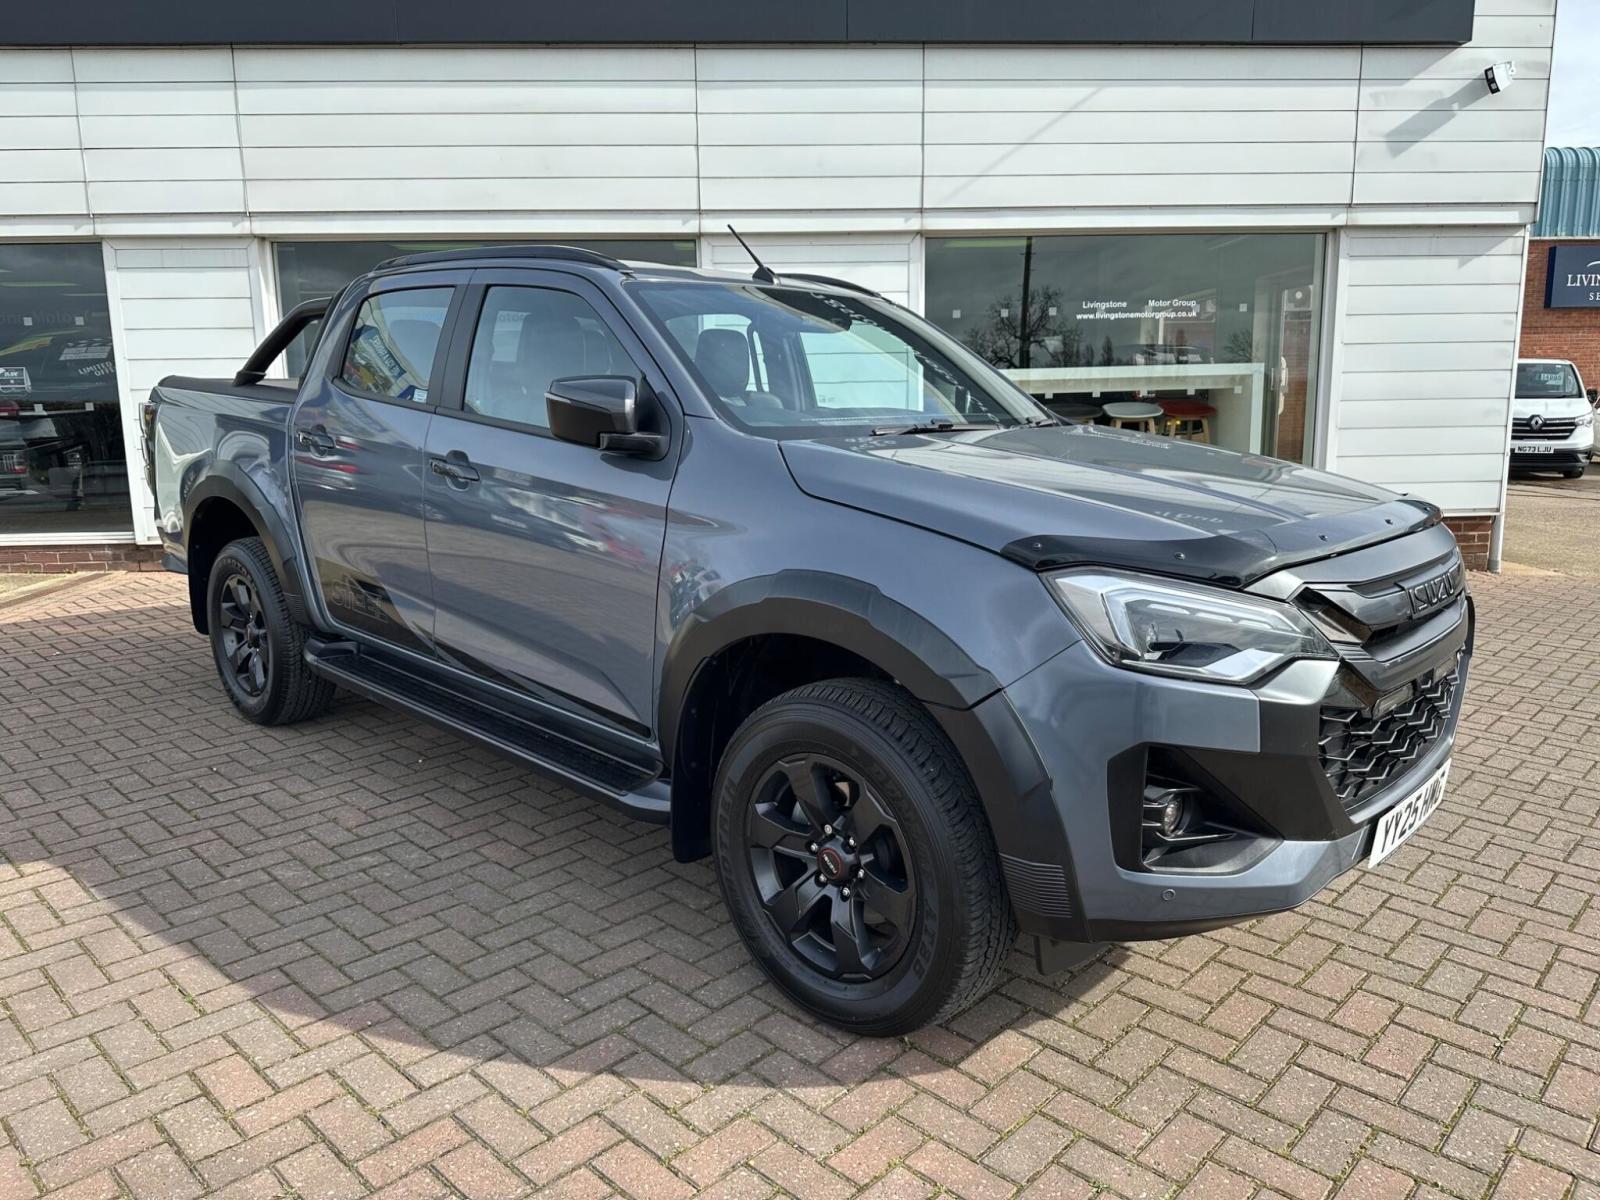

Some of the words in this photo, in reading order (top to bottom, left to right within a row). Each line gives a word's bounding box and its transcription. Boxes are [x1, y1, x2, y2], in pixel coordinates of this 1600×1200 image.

[1082, 301, 1127, 310] Livingstone
[1148, 299, 1171, 307] Motor
[1172, 299, 1197, 308] Group
[1076, 310, 1197, 320] www.livingstonemotorgroup.co.uk
[1517, 445, 1536, 453] NG73
[1537, 445, 1552, 453] LJU
[1408, 573, 1454, 614] ISUZU
[1381, 793, 1423, 853] YY25
